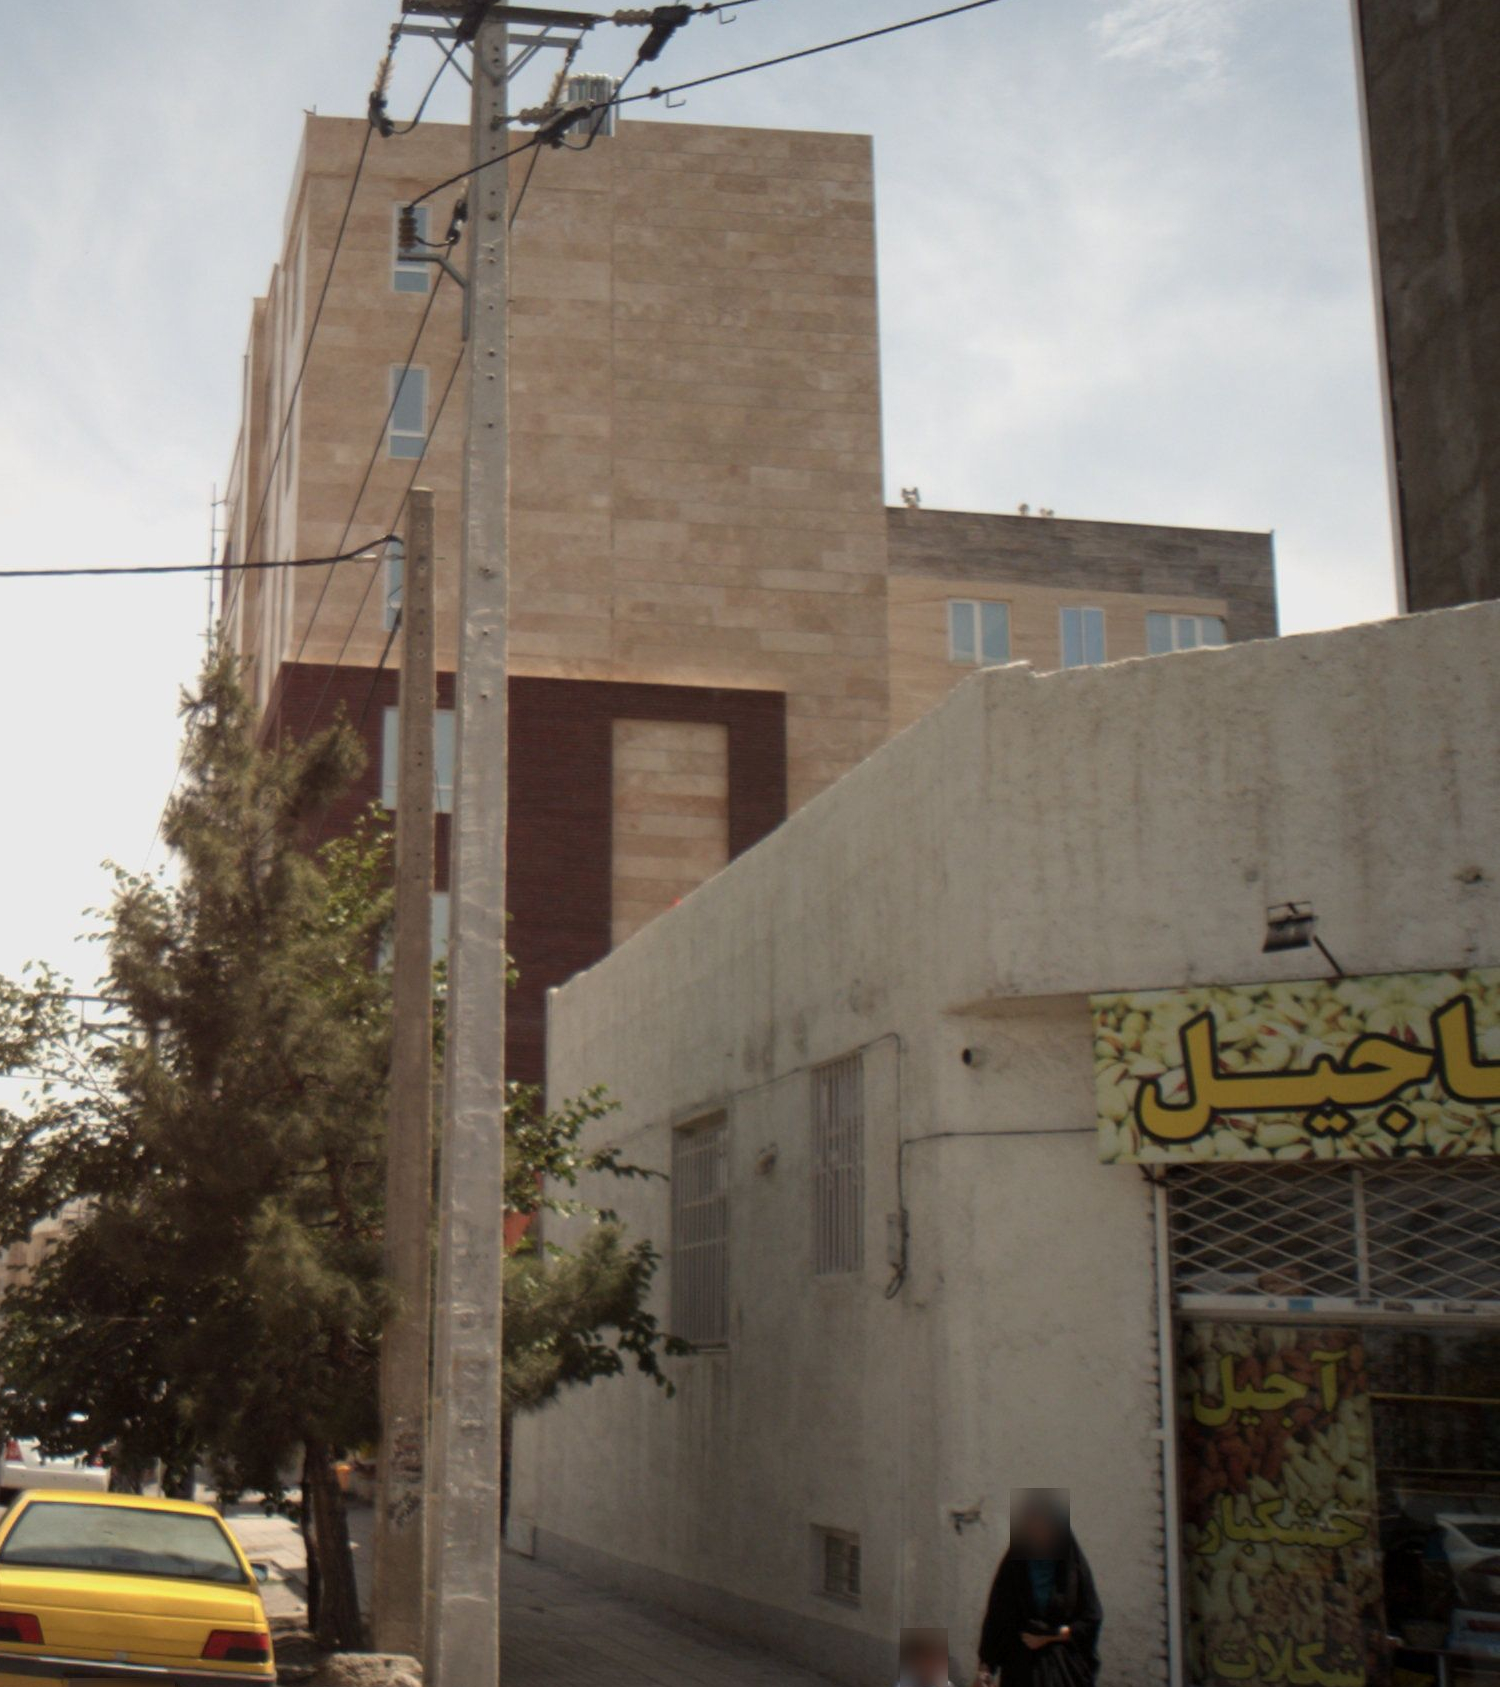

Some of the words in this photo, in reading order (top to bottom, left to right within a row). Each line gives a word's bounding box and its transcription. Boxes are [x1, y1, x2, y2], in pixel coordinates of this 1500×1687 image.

[1135, 994, 1500, 1144] اجیل
[1192, 1349, 1348, 1427] آجیل
[1195, 1494, 1367, 1556] خشکبار
[1212, 1632, 1366, 1687] شکلات
